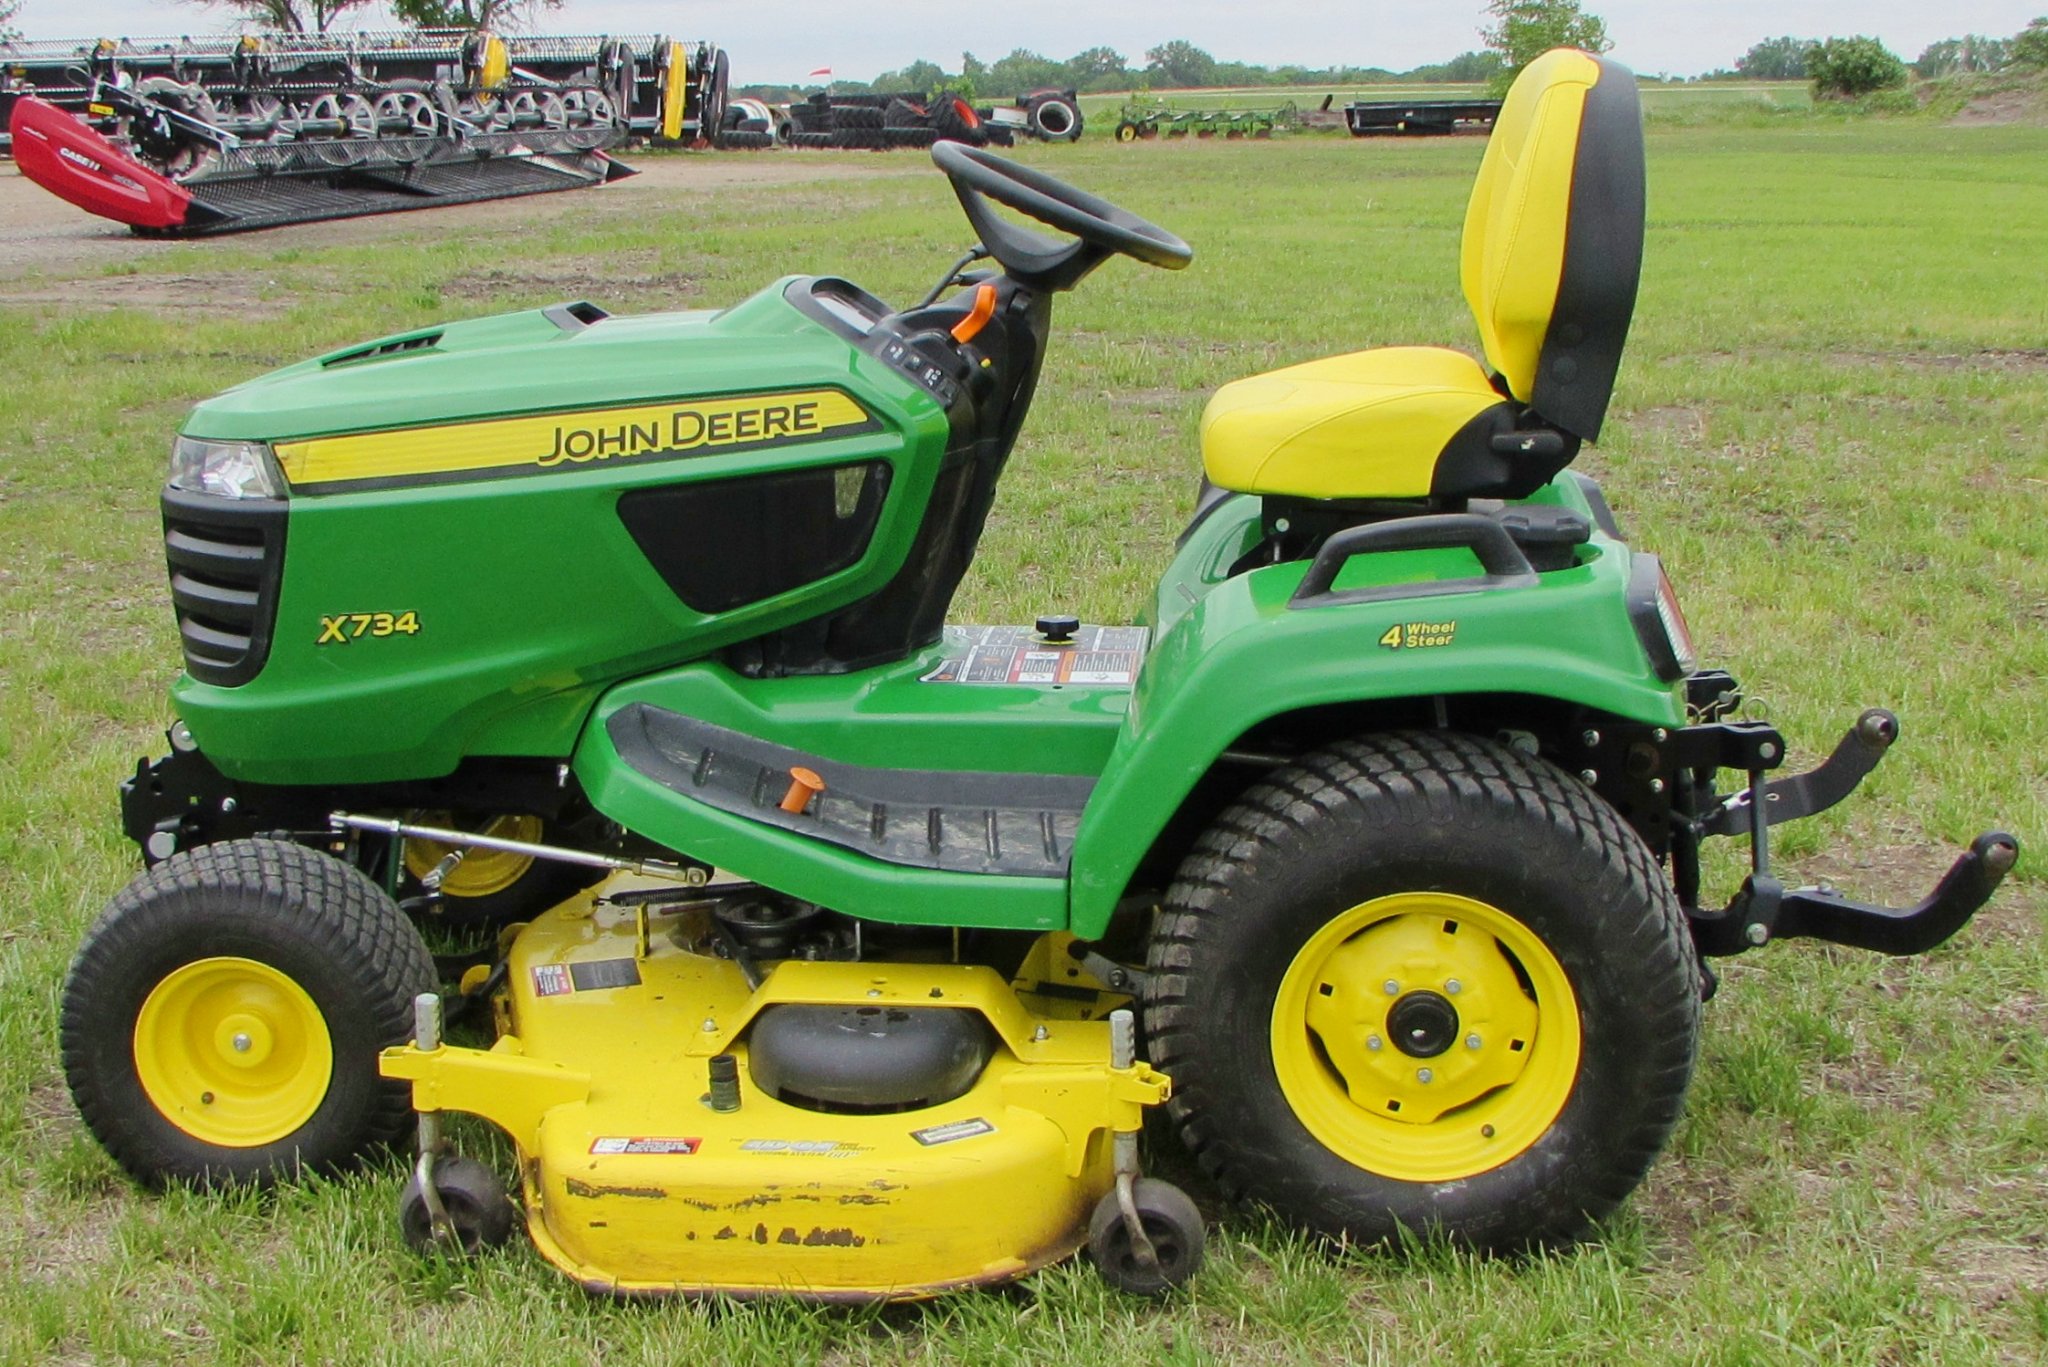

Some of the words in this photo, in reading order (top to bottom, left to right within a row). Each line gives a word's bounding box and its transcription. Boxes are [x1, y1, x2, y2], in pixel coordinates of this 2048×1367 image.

[60, 147, 90, 168] CASE
[538, 420, 659, 463] JOHN
[672, 402, 819, 446] DEERE
[317, 611, 420, 644] X734
[1379, 625, 1402, 648] 4
[1406, 620, 1456, 635] Wheel
[1406, 635, 1454, 648] Steer
